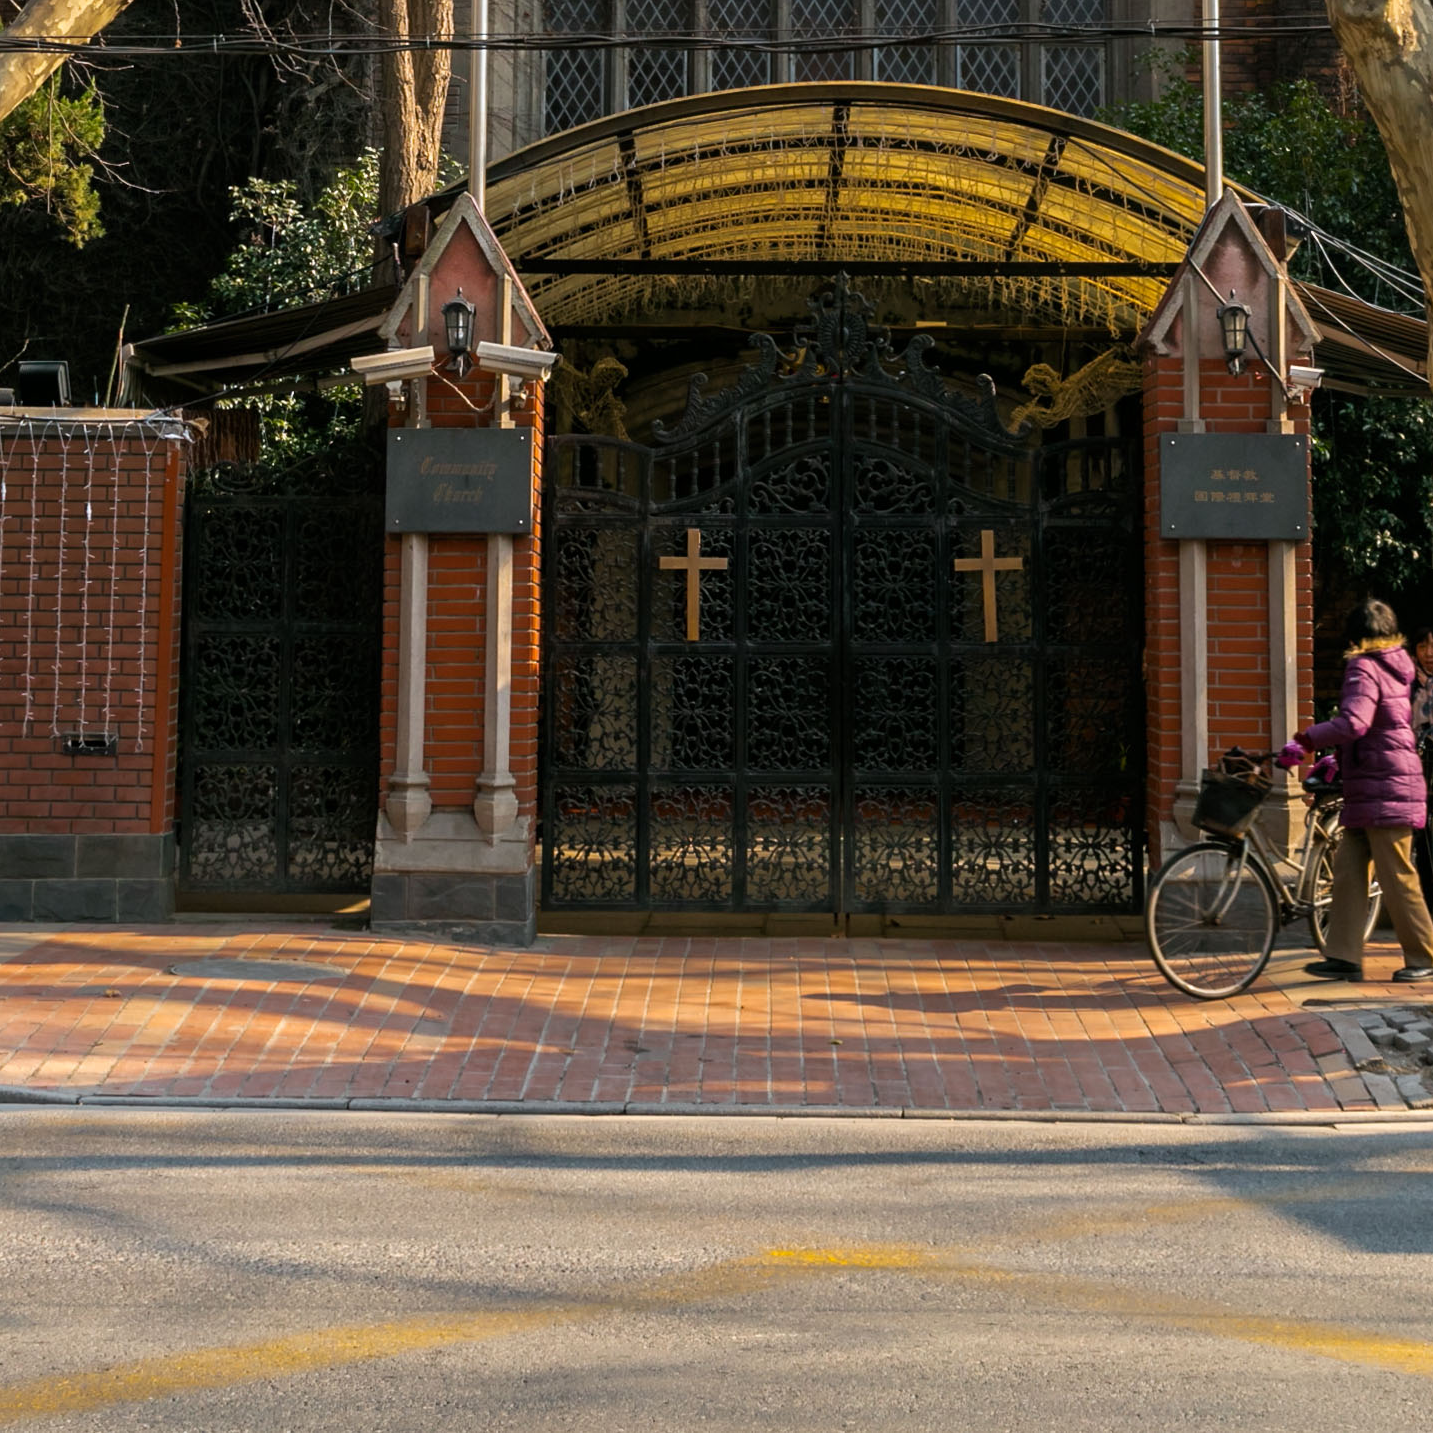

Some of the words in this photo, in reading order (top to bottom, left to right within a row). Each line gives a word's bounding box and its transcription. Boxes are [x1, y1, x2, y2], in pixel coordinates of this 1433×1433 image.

[419, 455, 498, 482] Community
[1210, 469, 1259, 481] 基督教
[431, 482, 484, 504] Church
